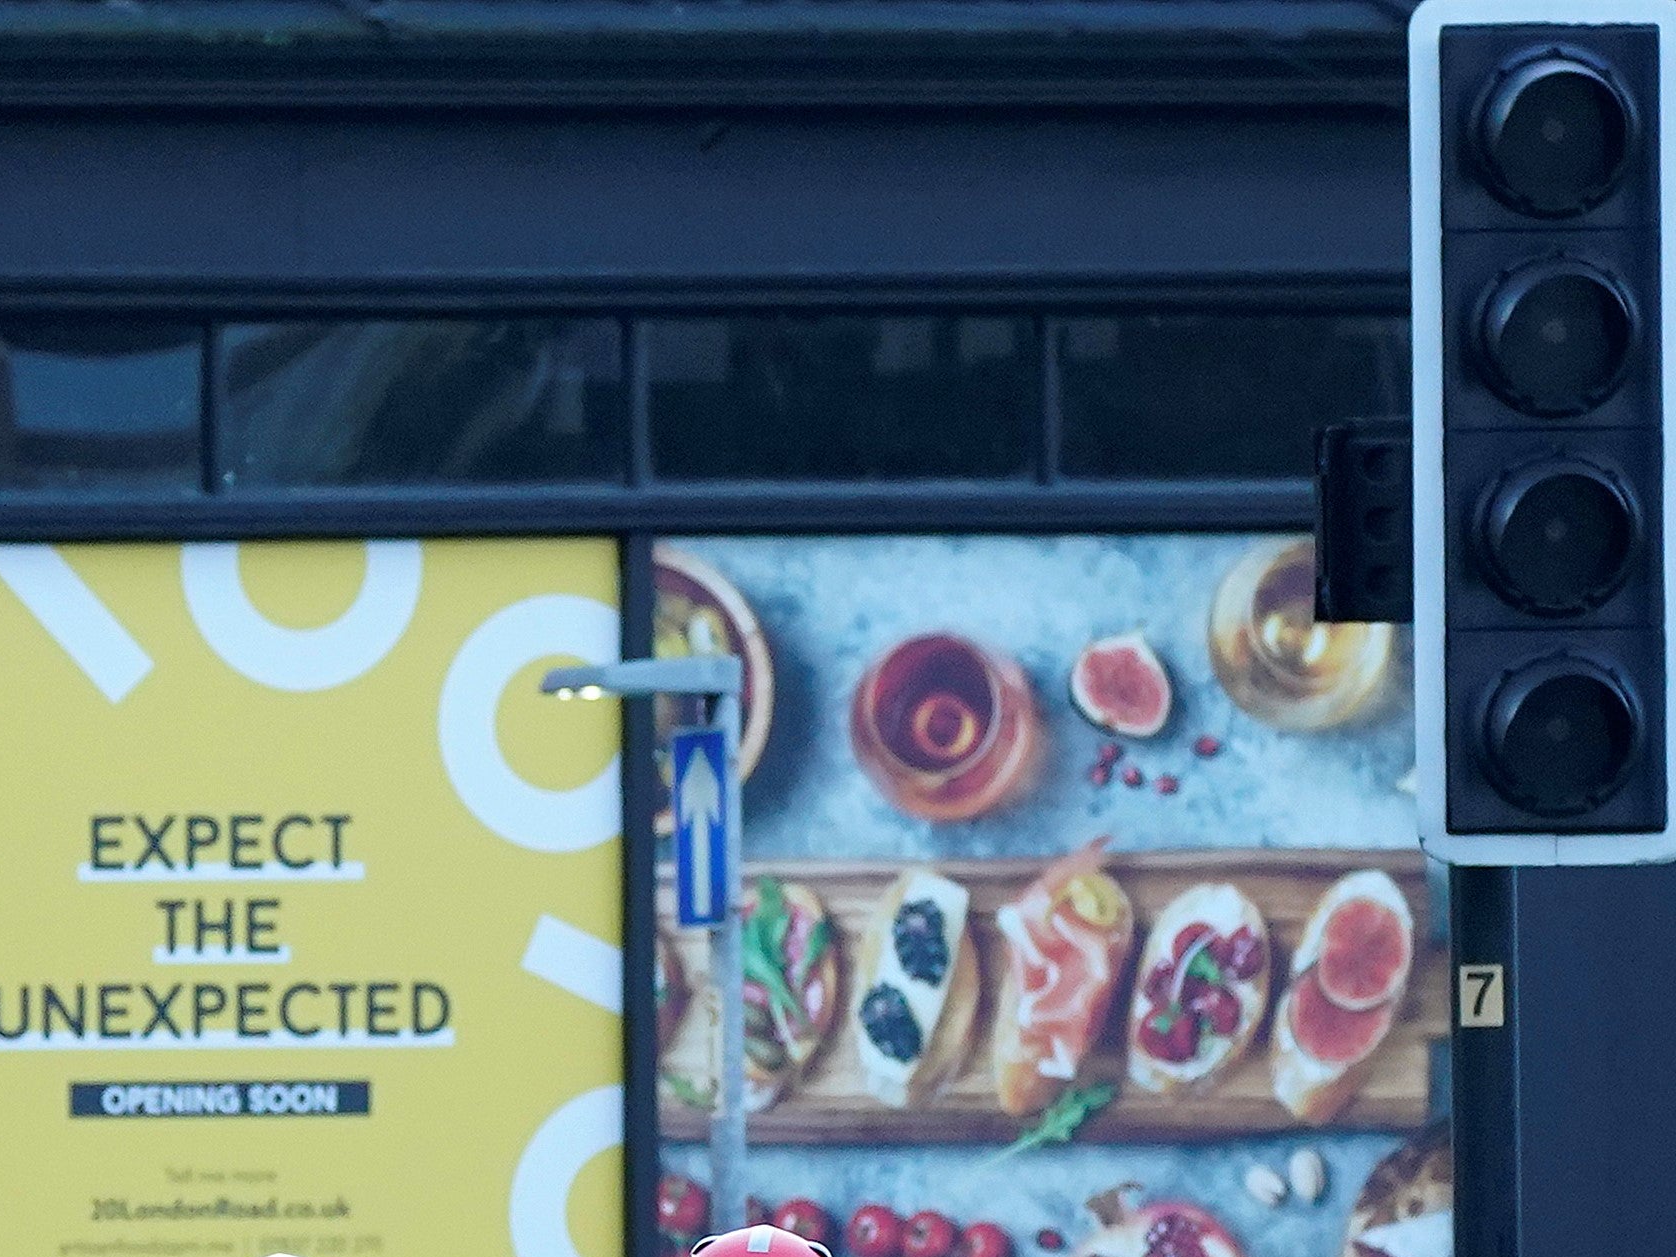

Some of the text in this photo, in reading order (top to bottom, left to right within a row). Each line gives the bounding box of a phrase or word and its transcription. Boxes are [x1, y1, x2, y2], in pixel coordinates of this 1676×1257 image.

[90, 814, 352, 870] EXPECT
[157, 899, 281, 954] THE
[1466, 972, 1495, 1017] 7
[102, 1085, 338, 1115] OPENING SOON
